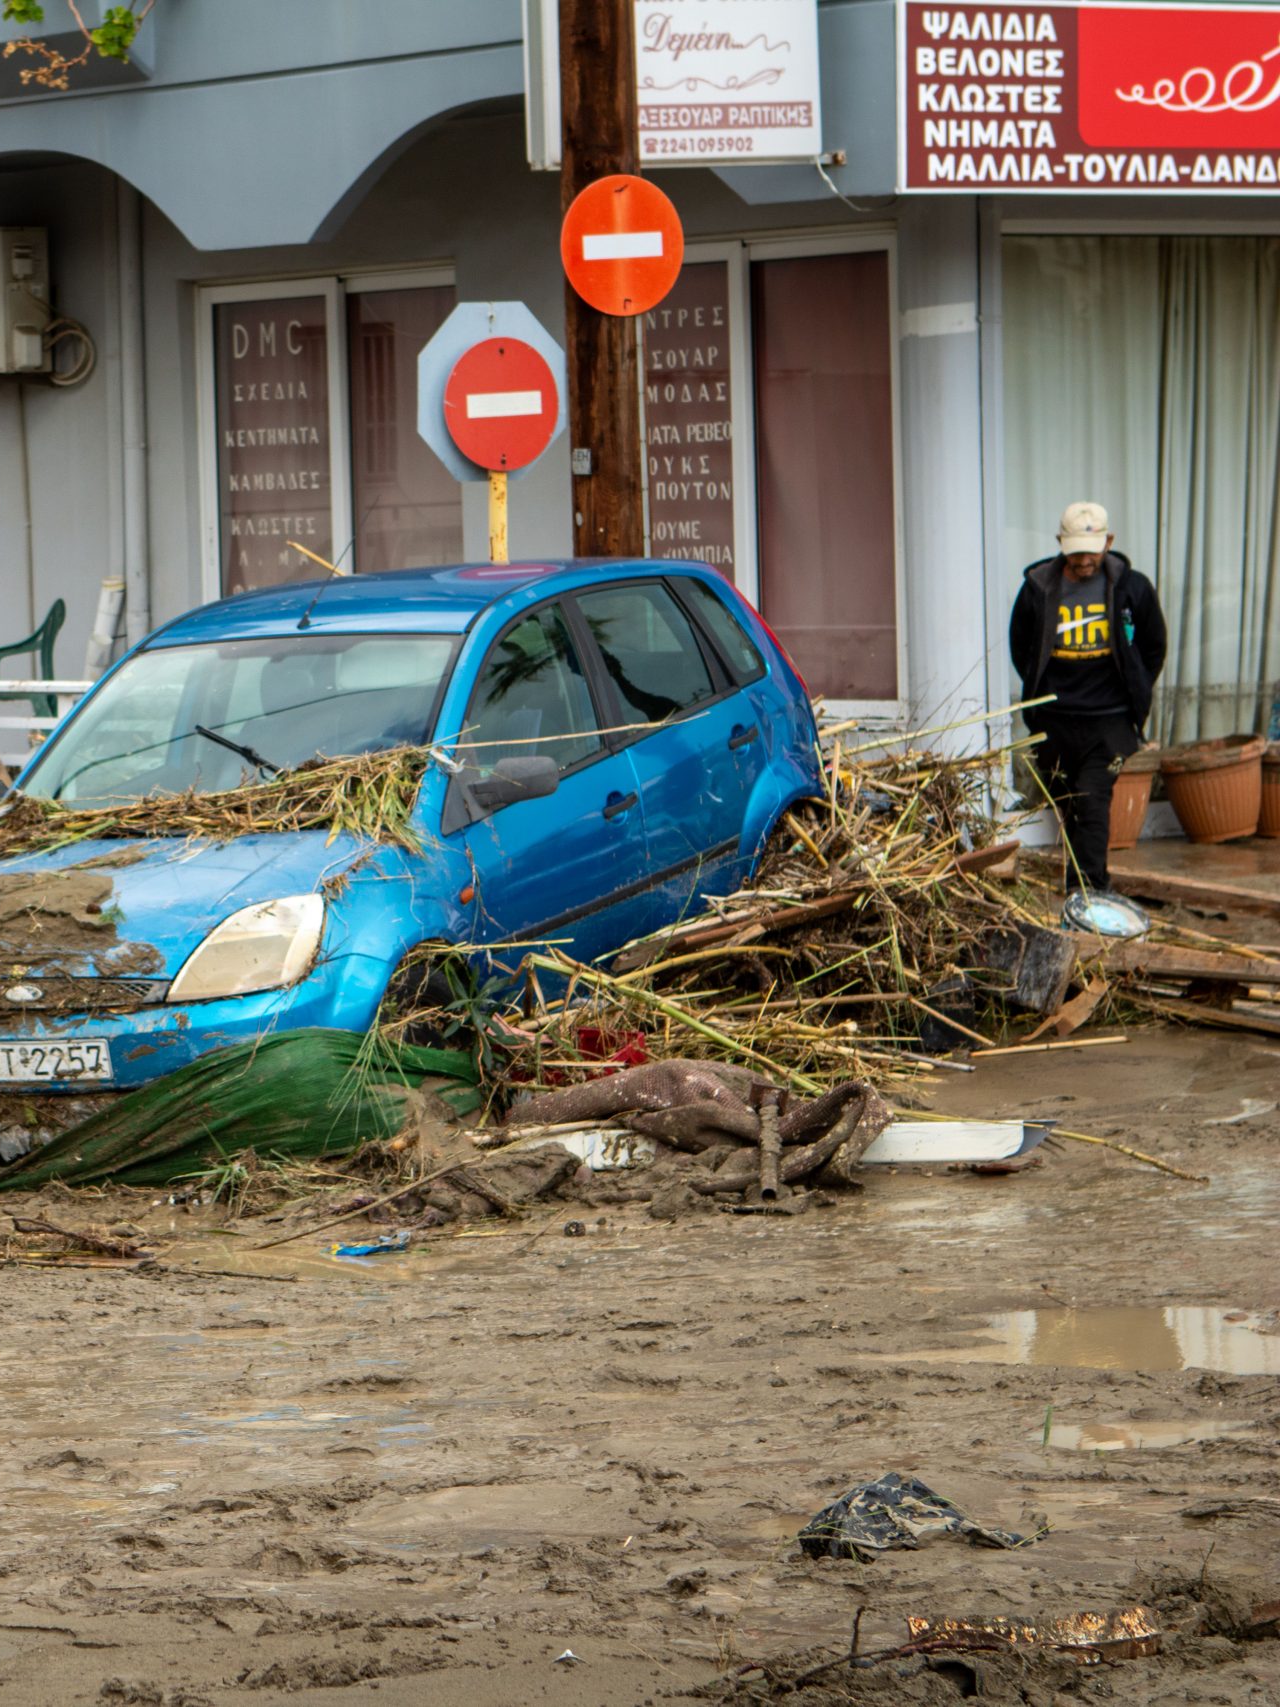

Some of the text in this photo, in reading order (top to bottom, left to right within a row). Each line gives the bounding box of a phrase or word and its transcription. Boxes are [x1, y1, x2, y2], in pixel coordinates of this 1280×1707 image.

[922, 11, 1057, 42] ΨΑΛΙΔΙΑ
[916, 47, 1065, 78] ΒΕΛΟΝΕΣ
[918, 83, 1062, 113] ΚΛΩΣΤΕΣ
[639, 105, 808, 128] ΑΞΕΣΟΥΑΡ ΡΑΠΤΙΚΗΣ
[661, 137, 754, 152] 2241095902
[924, 119, 1057, 148] ΝΗΜΑΤΑ
[928, 153, 1280, 183] ΜΑΛΛΙΑ-ΤΟΥΛΙΑ-ΔΑΝΔ
[232, 320, 303, 359] DMC
[234, 381, 308, 402] ΣΧΕΔΙΑ
[647, 382, 727, 404] ΜΟΔΑΣ
[224, 427, 320, 448] ΚΕΝΤΗΜΑΤΑ
[648, 425, 681, 445] ΑΤΑ
[229, 471, 321, 492] ΚΑΜΒΑΔΕΣ
[231, 517, 316, 536] ΚΛΩΣΤΕΣ
[30, 1045, 103, 1077] 2257
